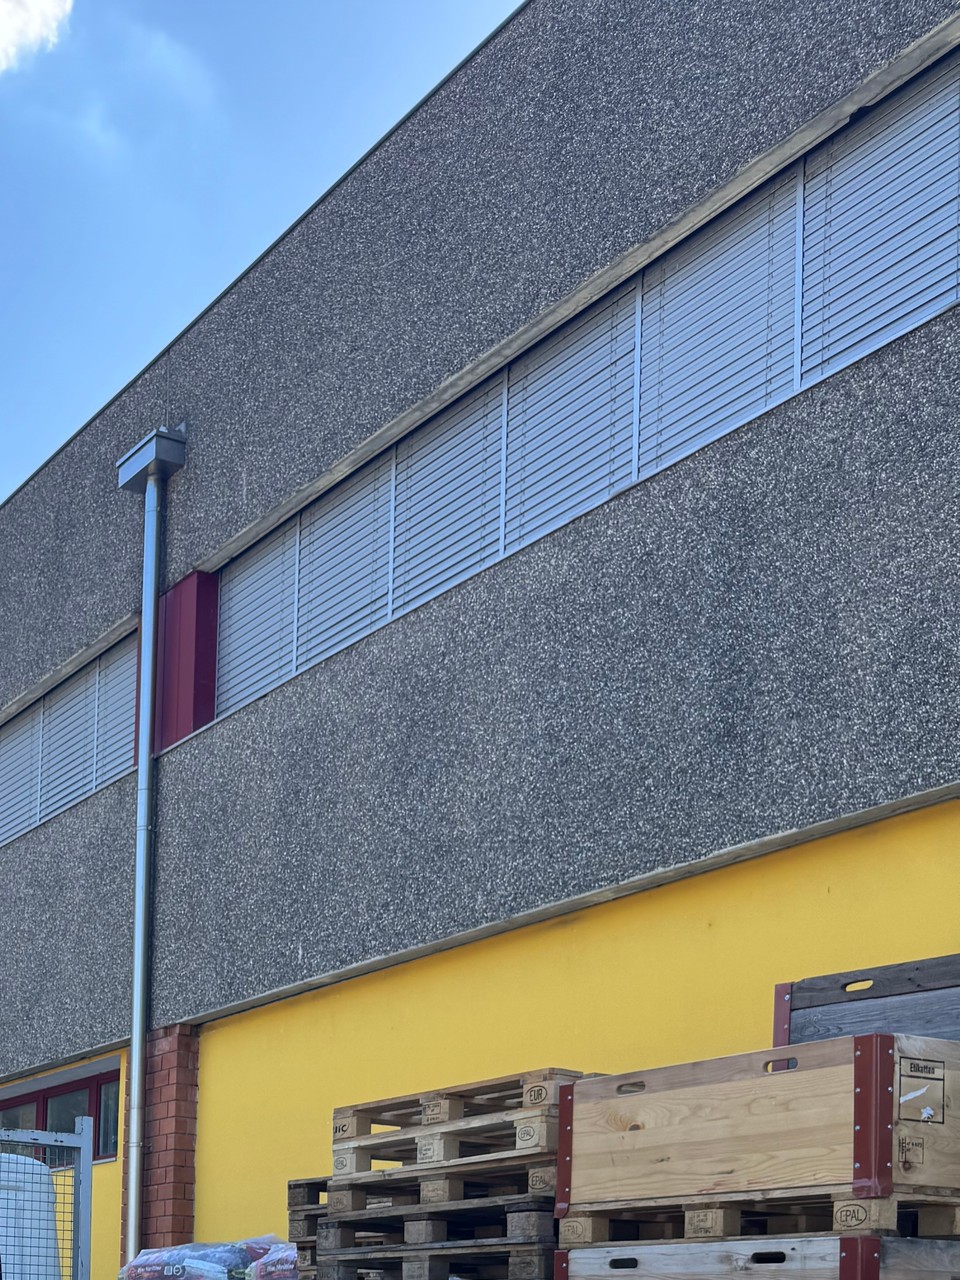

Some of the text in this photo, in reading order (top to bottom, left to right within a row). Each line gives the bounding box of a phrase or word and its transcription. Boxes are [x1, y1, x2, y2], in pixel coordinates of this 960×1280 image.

[529, 1085, 544, 1102] EUR
[531, 1173, 548, 1186] EPAL
[839, 1208, 863, 1223] EPAL
